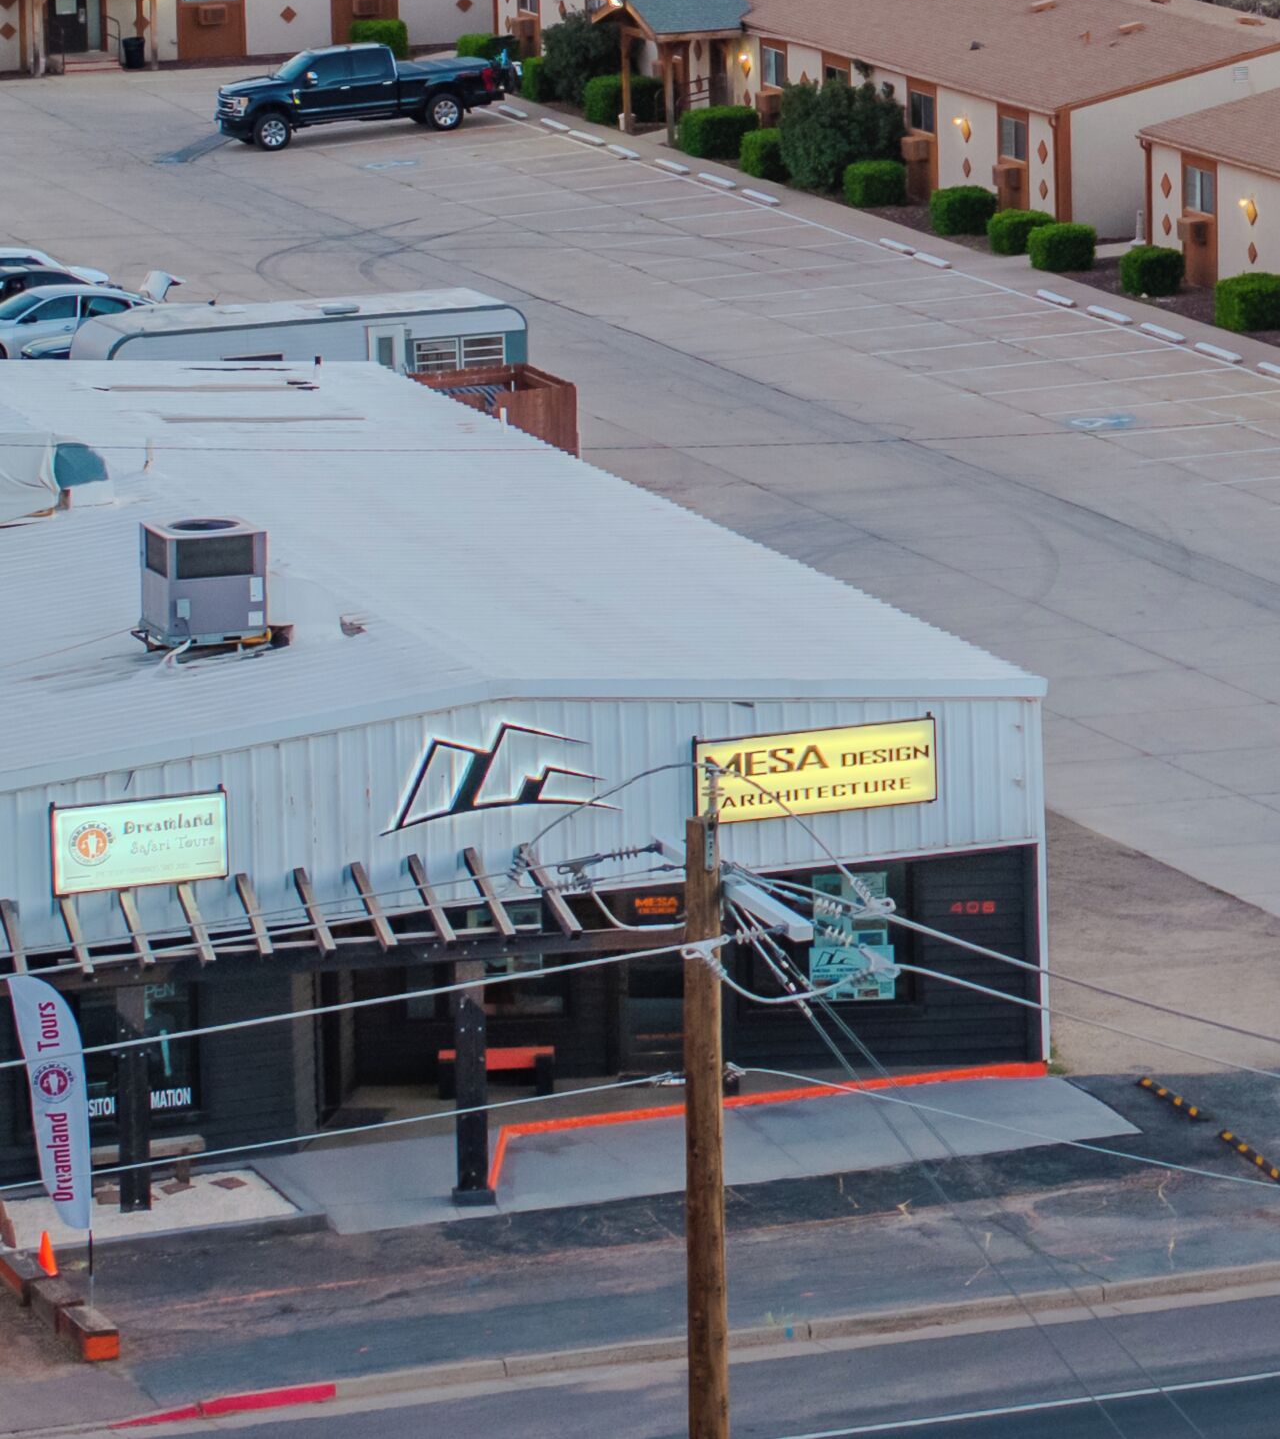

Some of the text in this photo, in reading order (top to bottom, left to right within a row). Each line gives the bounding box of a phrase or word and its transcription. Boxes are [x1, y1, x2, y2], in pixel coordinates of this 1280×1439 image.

[704, 744, 930, 780] MESA DESIGN
[721, 777, 912, 809] ARCHITECTURE
[123, 812, 214, 835] Dreamland
[130, 838, 171, 857] Safari
[175, 834, 216, 849] Tours
[37, 1001, 60, 1052] Tours
[150, 1087, 192, 1110] MATION
[45, 1112, 75, 1202] Dreamland
